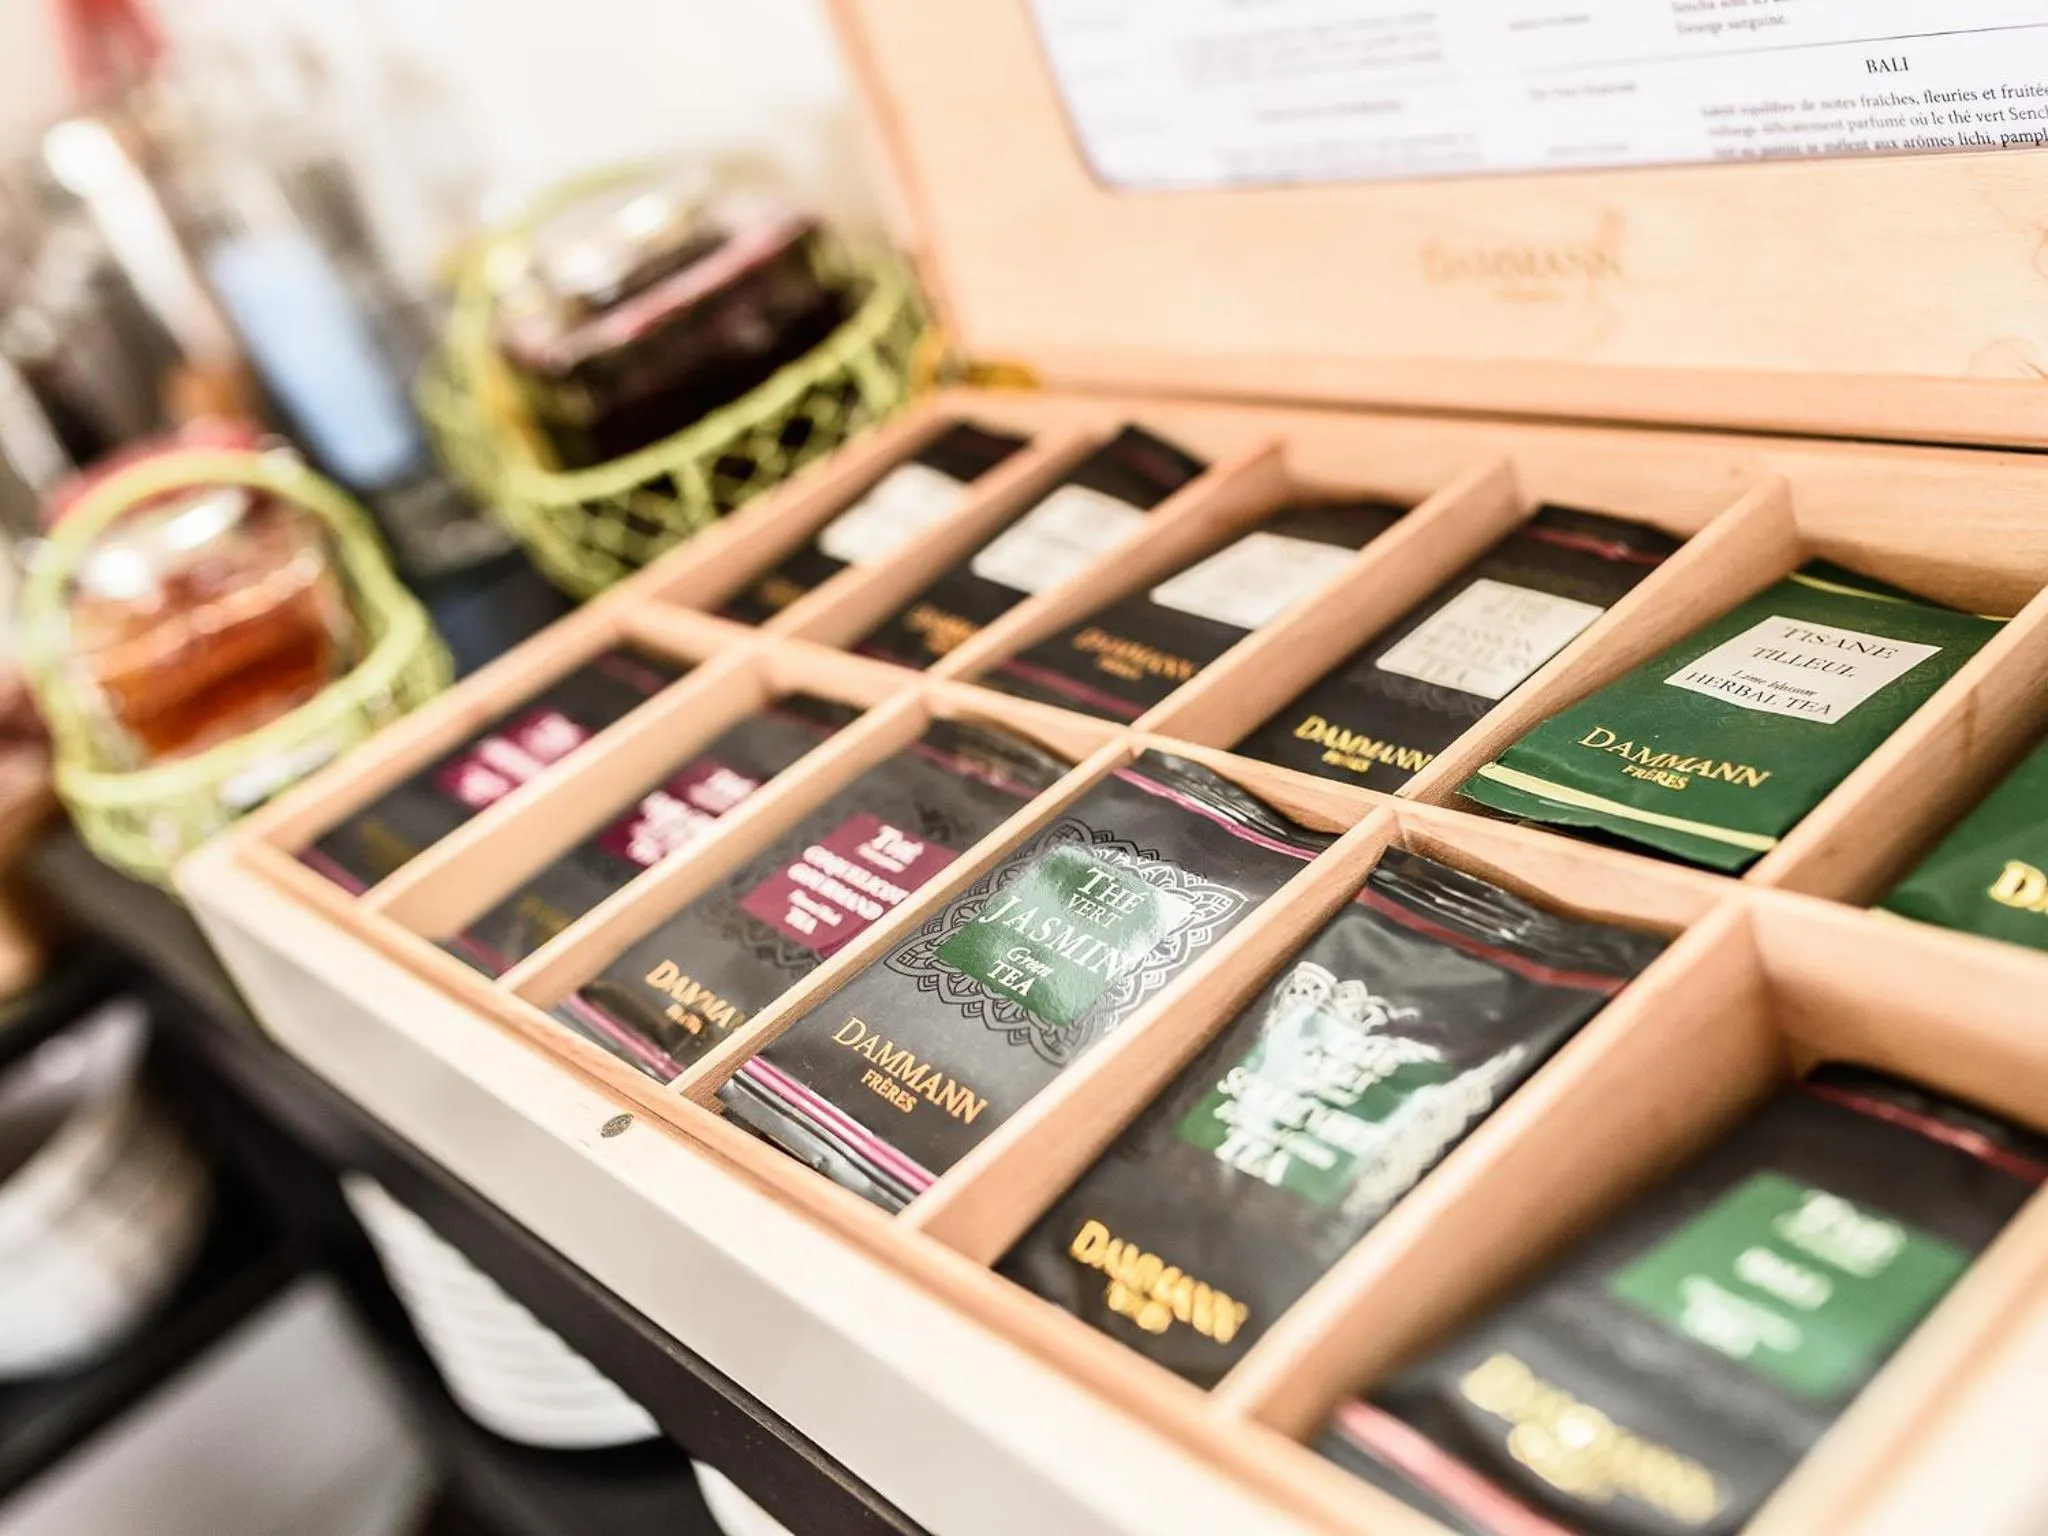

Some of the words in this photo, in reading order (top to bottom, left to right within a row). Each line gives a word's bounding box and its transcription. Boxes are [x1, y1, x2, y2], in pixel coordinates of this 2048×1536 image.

[1865, 56, 1910, 74] BALI
[1923, 88, 1978, 104] fleuries
[1982, 89, 1997, 100] et
[1931, 111, 1945, 125] le
[1948, 110, 1972, 124] thé
[1975, 110, 2006, 122] vert
[1874, 140, 1899, 150] aux
[1903, 135, 1955, 149] arômes
[1957, 130, 1997, 145] lichi,
[1781, 626, 1899, 660] TISANE
[1731, 670, 1768, 687] Lime
[1751, 646, 1856, 678] TILLEUL
[1685, 671, 1778, 706] HERBAL
[1784, 696, 1833, 716] TEA
[1579, 726, 1773, 789] DAMMANN
[1078, 867, 1149, 914] THÉ
[1066, 893, 1124, 929] VERT
[978, 895, 1129, 981] JASMIN
[987, 959, 1038, 997] TEA
[1006, 946, 1055, 978] Green
[831, 1016, 989, 1125] DAMMANN
[860, 1068, 919, 1114] FRÈRES
